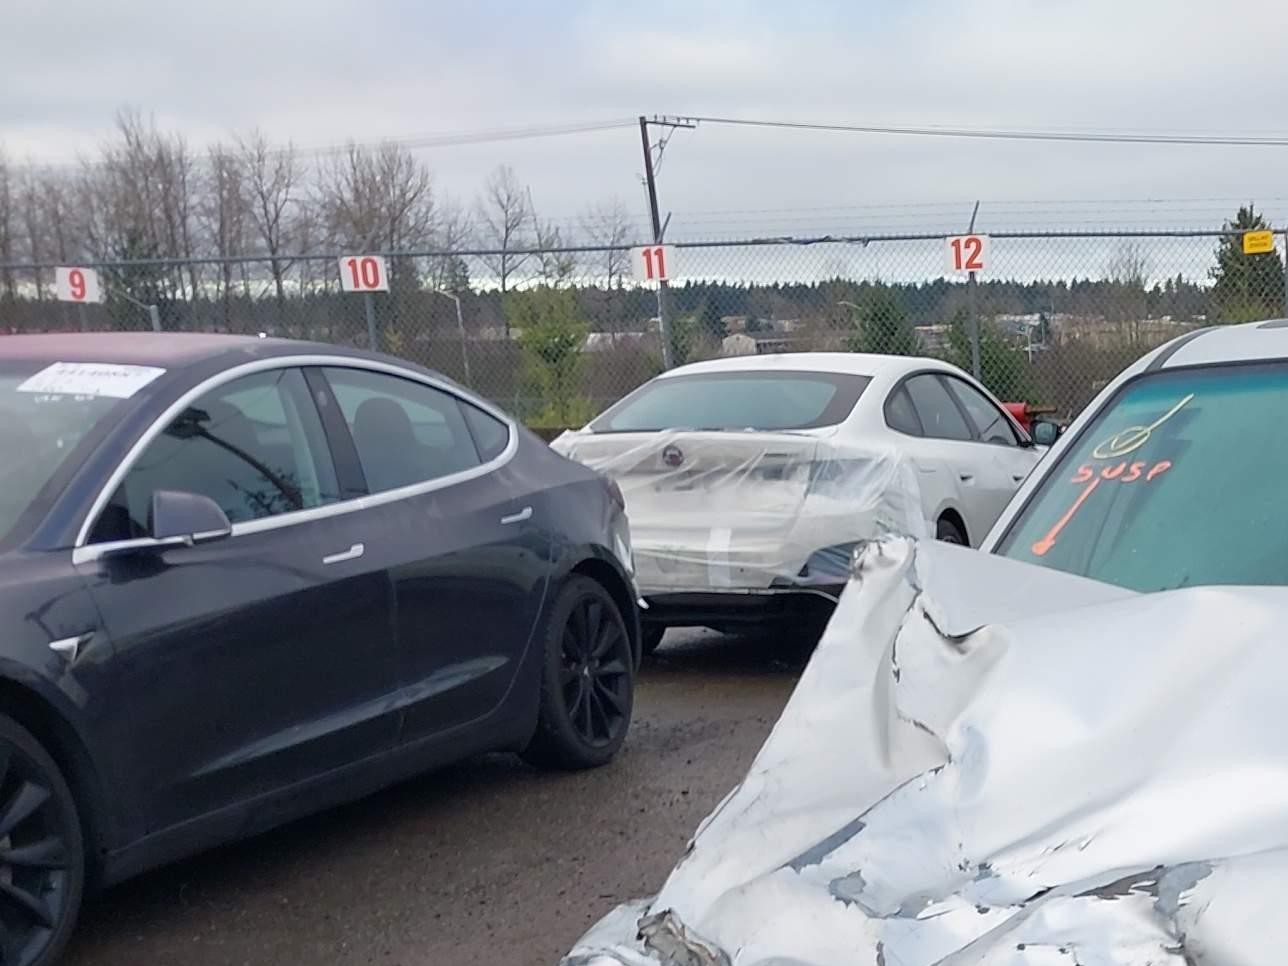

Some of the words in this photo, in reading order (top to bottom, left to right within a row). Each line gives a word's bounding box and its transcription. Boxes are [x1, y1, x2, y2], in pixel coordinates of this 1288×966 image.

[642, 248, 665, 279] 11
[951, 237, 983, 270] 12
[69, 270, 86, 300] 9
[348, 258, 380, 289] 10
